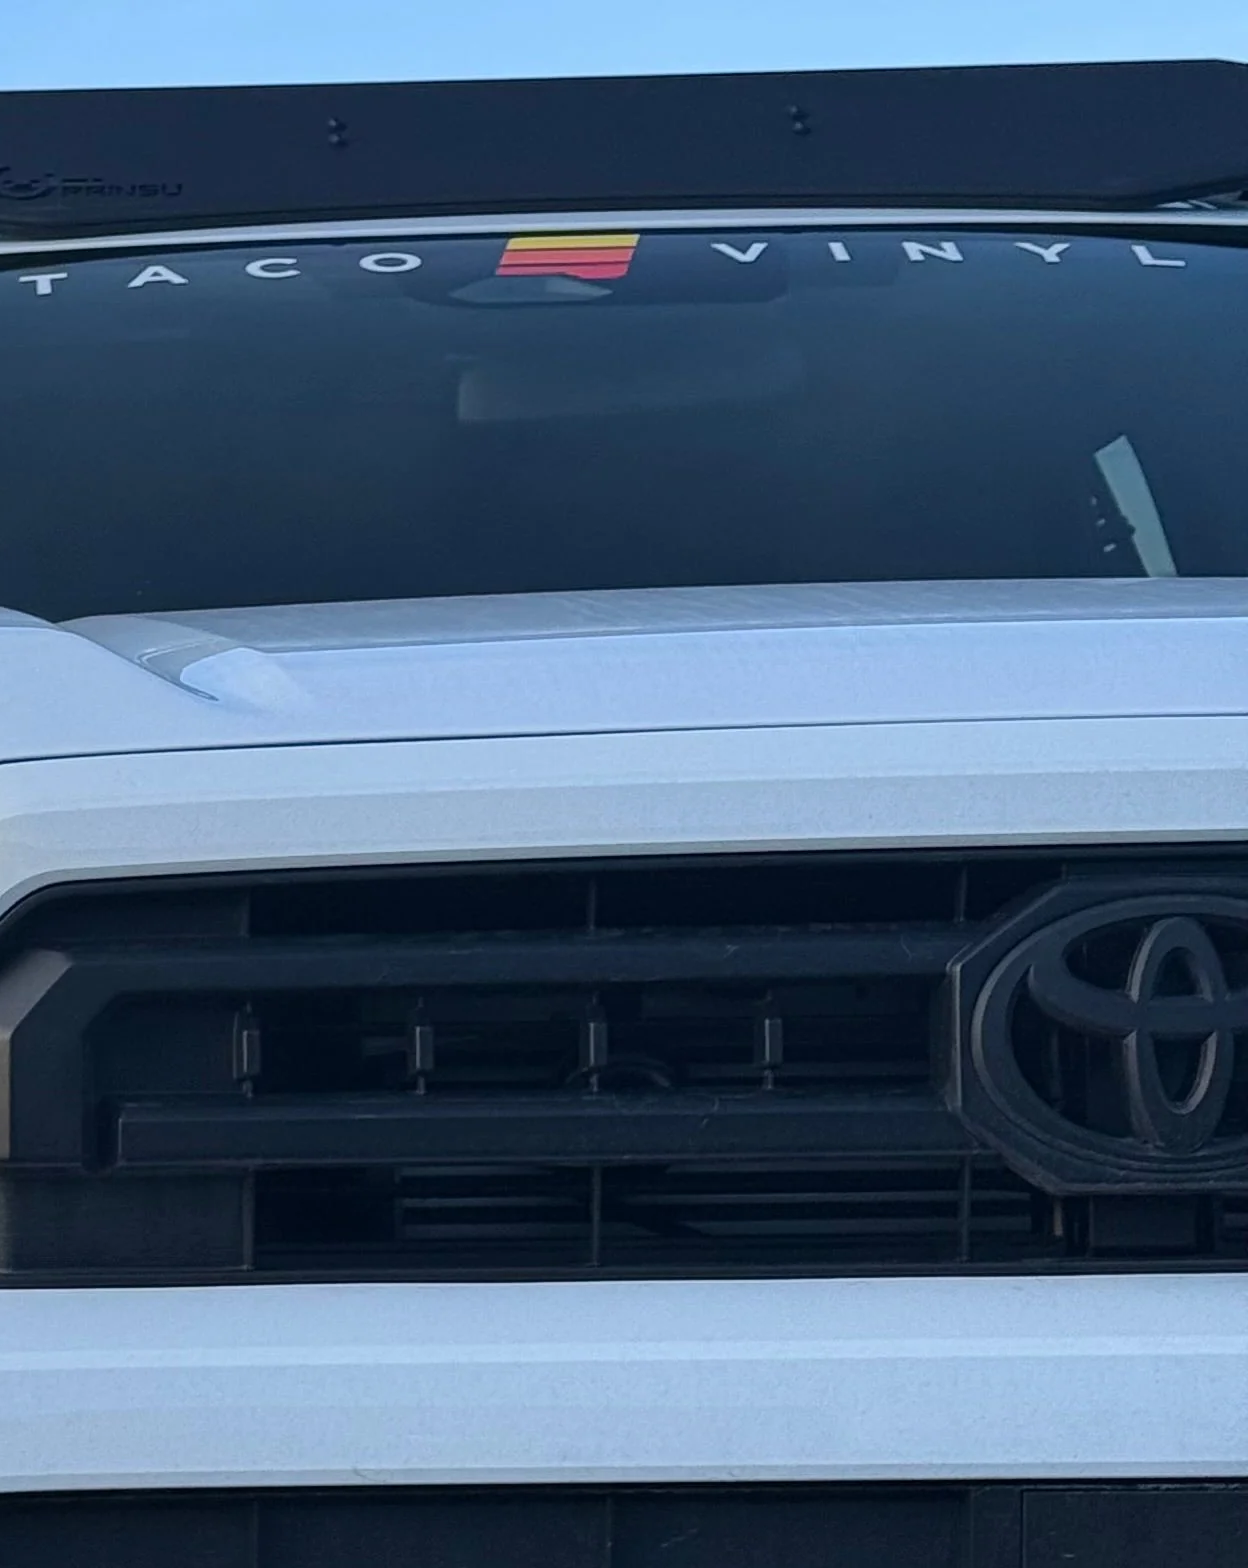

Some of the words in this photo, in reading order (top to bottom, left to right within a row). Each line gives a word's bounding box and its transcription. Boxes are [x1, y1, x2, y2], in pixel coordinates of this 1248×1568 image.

[61, 179, 184, 198] PRINSU
[18, 251, 423, 296] TACO
[710, 240, 1188, 267] VINYL
